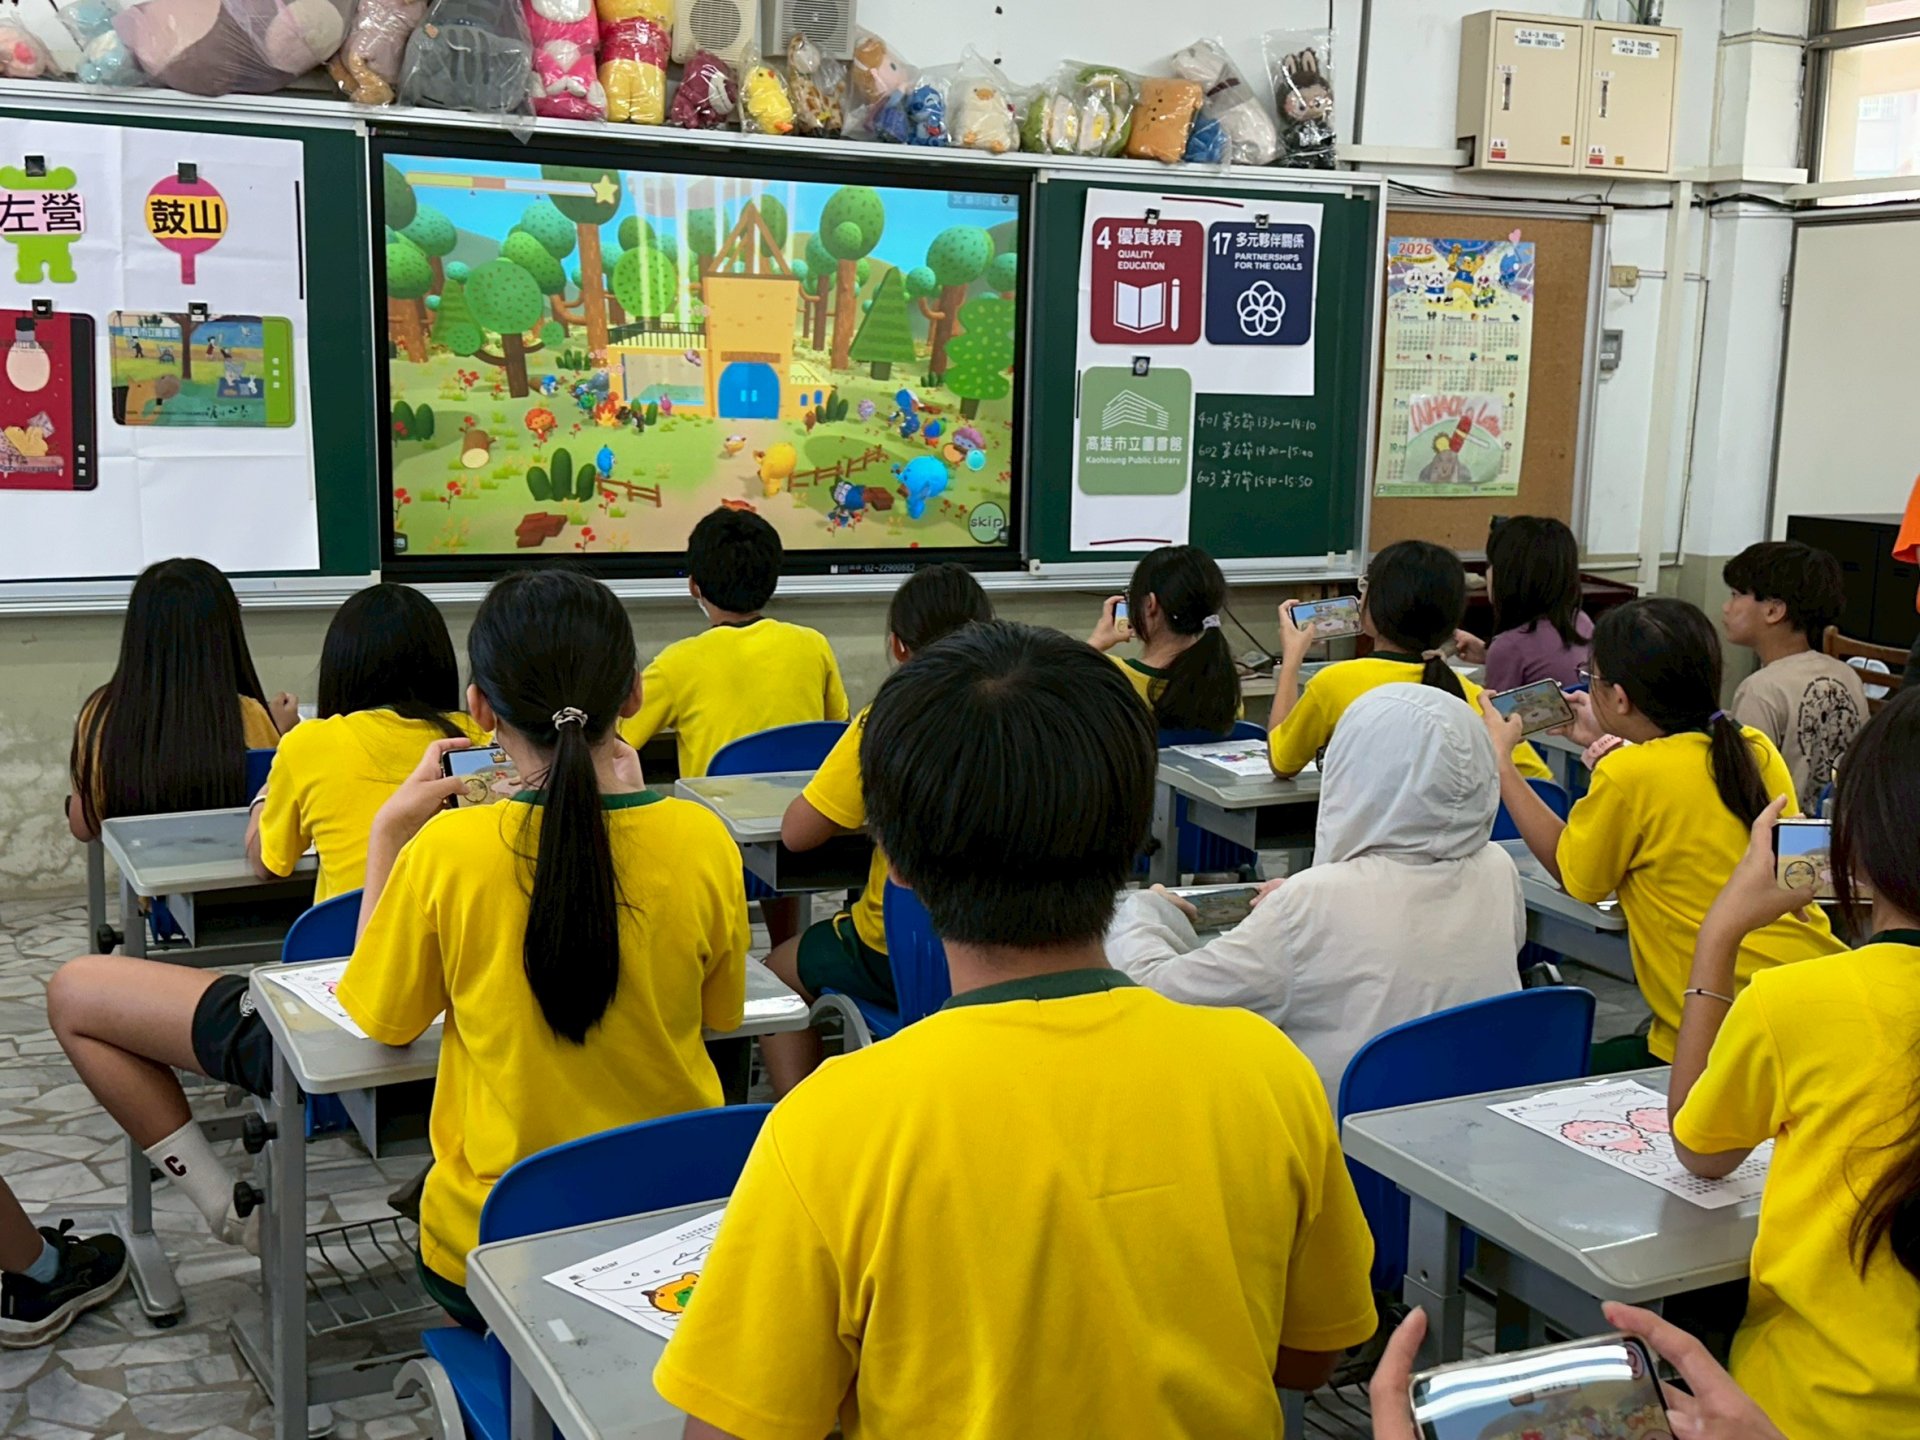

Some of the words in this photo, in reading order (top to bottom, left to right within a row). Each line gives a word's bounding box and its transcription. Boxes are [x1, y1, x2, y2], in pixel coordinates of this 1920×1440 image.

[0, 193, 82, 233] 左營
[150, 199, 222, 235] 鼓山
[1096, 226, 1112, 250] 4
[1117, 227, 1183, 247] 優質教育
[1212, 232, 1232, 256] 17
[1236, 232, 1305, 249] 多元夥伴關係
[1117, 250, 1154, 260] QUALITY
[1399, 243, 1433, 256] 2026
[1234, 252, 1300, 263] PARTNERSHIPS
[1117, 261, 1165, 271] EDUCATION
[1234, 262, 1253, 270] FOR
[1255, 263, 1271, 271] THE
[1273, 263, 1303, 272] GOALS
[1086, 436, 1183, 452] 高雄市立圖書館
[1198, 444, 1217, 458] 602
[1086, 456, 1127, 466] Kaohsiung
[1128, 456, 1152, 465] Public
[1153, 456, 1181, 465] Library
[1196, 470, 1216, 487] 603
[970, 515, 1003, 529] skip
[164, 1156, 187, 1177] C
[592, 1261, 619, 1273] Bear
